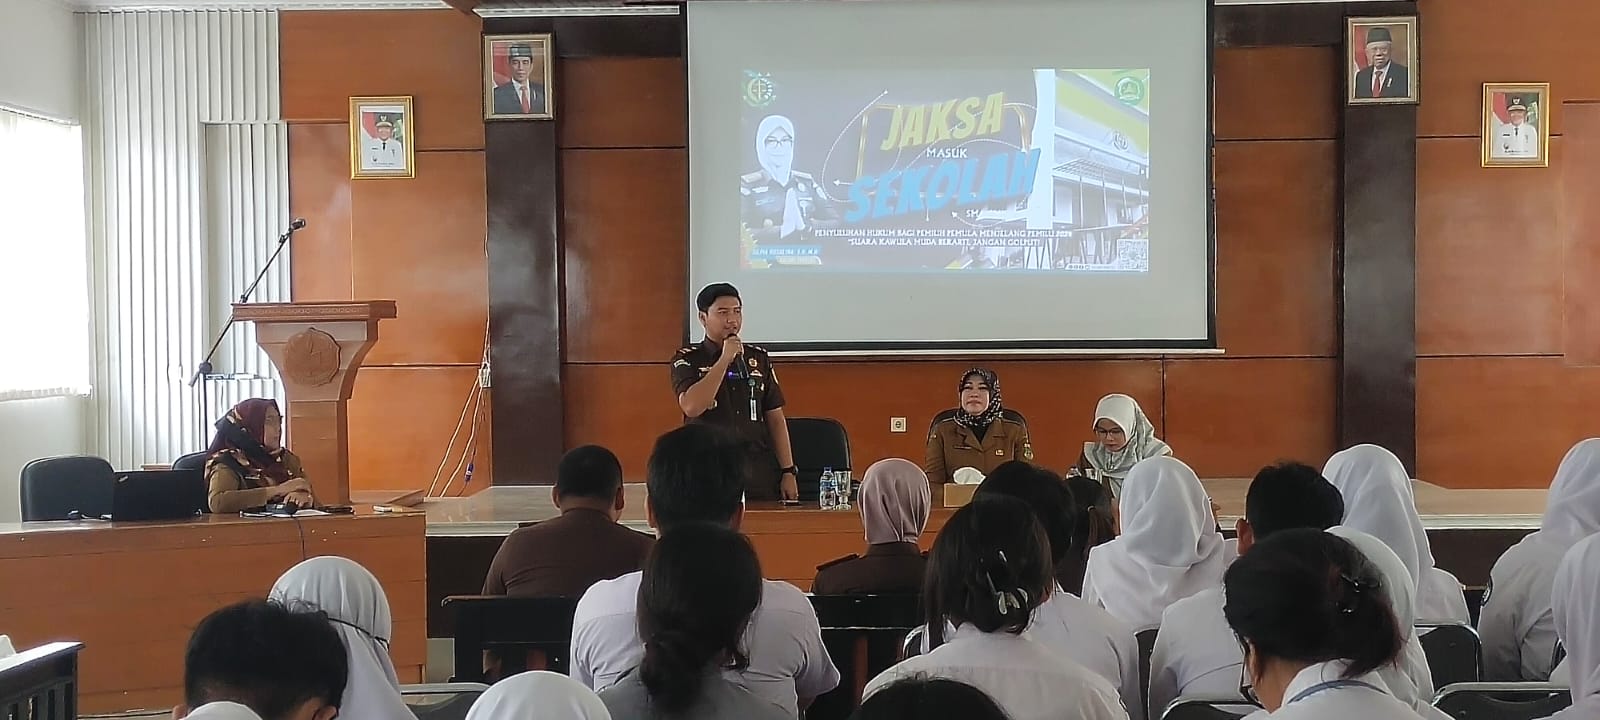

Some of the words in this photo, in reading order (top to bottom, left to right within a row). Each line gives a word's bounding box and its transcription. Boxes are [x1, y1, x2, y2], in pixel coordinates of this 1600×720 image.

[880, 92, 1005, 151] JAKSA
[926, 147, 968, 159] MASUK
[844, 147, 1042, 225] SEKOLAH
[814, 229, 865, 237] PENYULUHAN
[867, 229, 895, 237] HUKUM
[897, 229, 915, 237] BAGI
[947, 229, 978, 237] PEMULA
[979, 229, 1026, 237] MENJELANG
[879, 238, 913, 246] KAWULA
[914, 238, 937, 246] MUDA
[973, 238, 1006, 246] JANGAN
